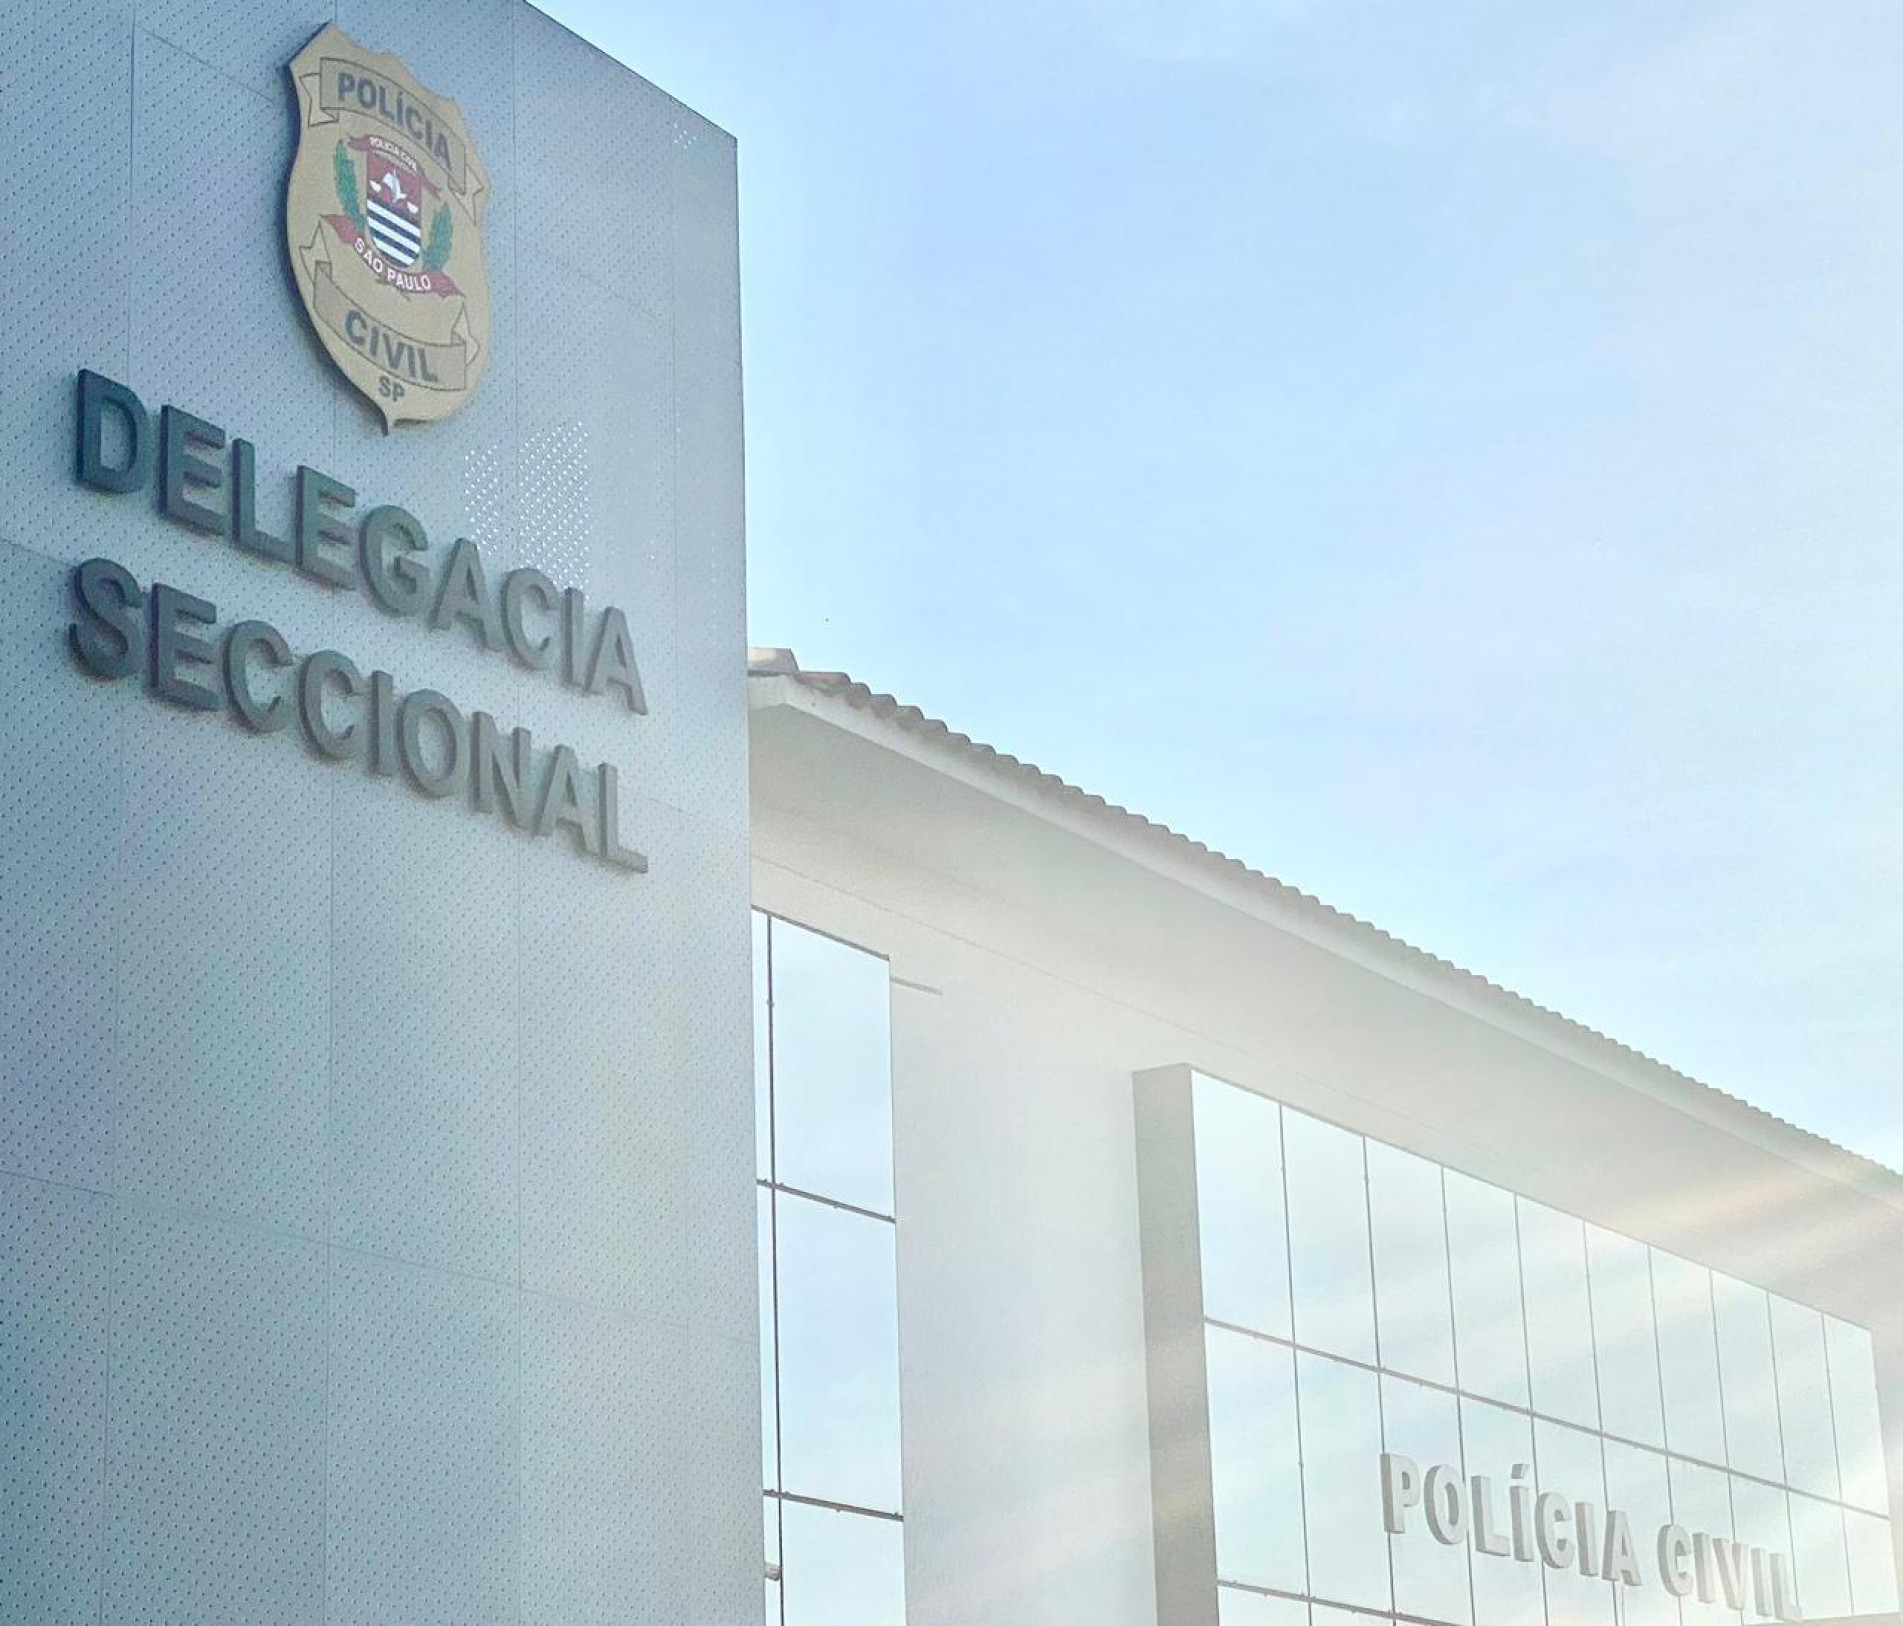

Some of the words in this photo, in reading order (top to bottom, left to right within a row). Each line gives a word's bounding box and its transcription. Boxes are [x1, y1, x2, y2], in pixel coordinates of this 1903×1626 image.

[338, 72, 452, 171] POLÍCIA
[387, 267, 431, 290] PAULO
[345, 309, 438, 382] CIVIL
[379, 375, 405, 402] SP
[75, 368, 649, 716] DELEGACIA
[67, 557, 649, 874] SECCIONAL
[1380, 1453, 1642, 1587] POLÍCIA
[1658, 1524, 1801, 1621] CIVIL
